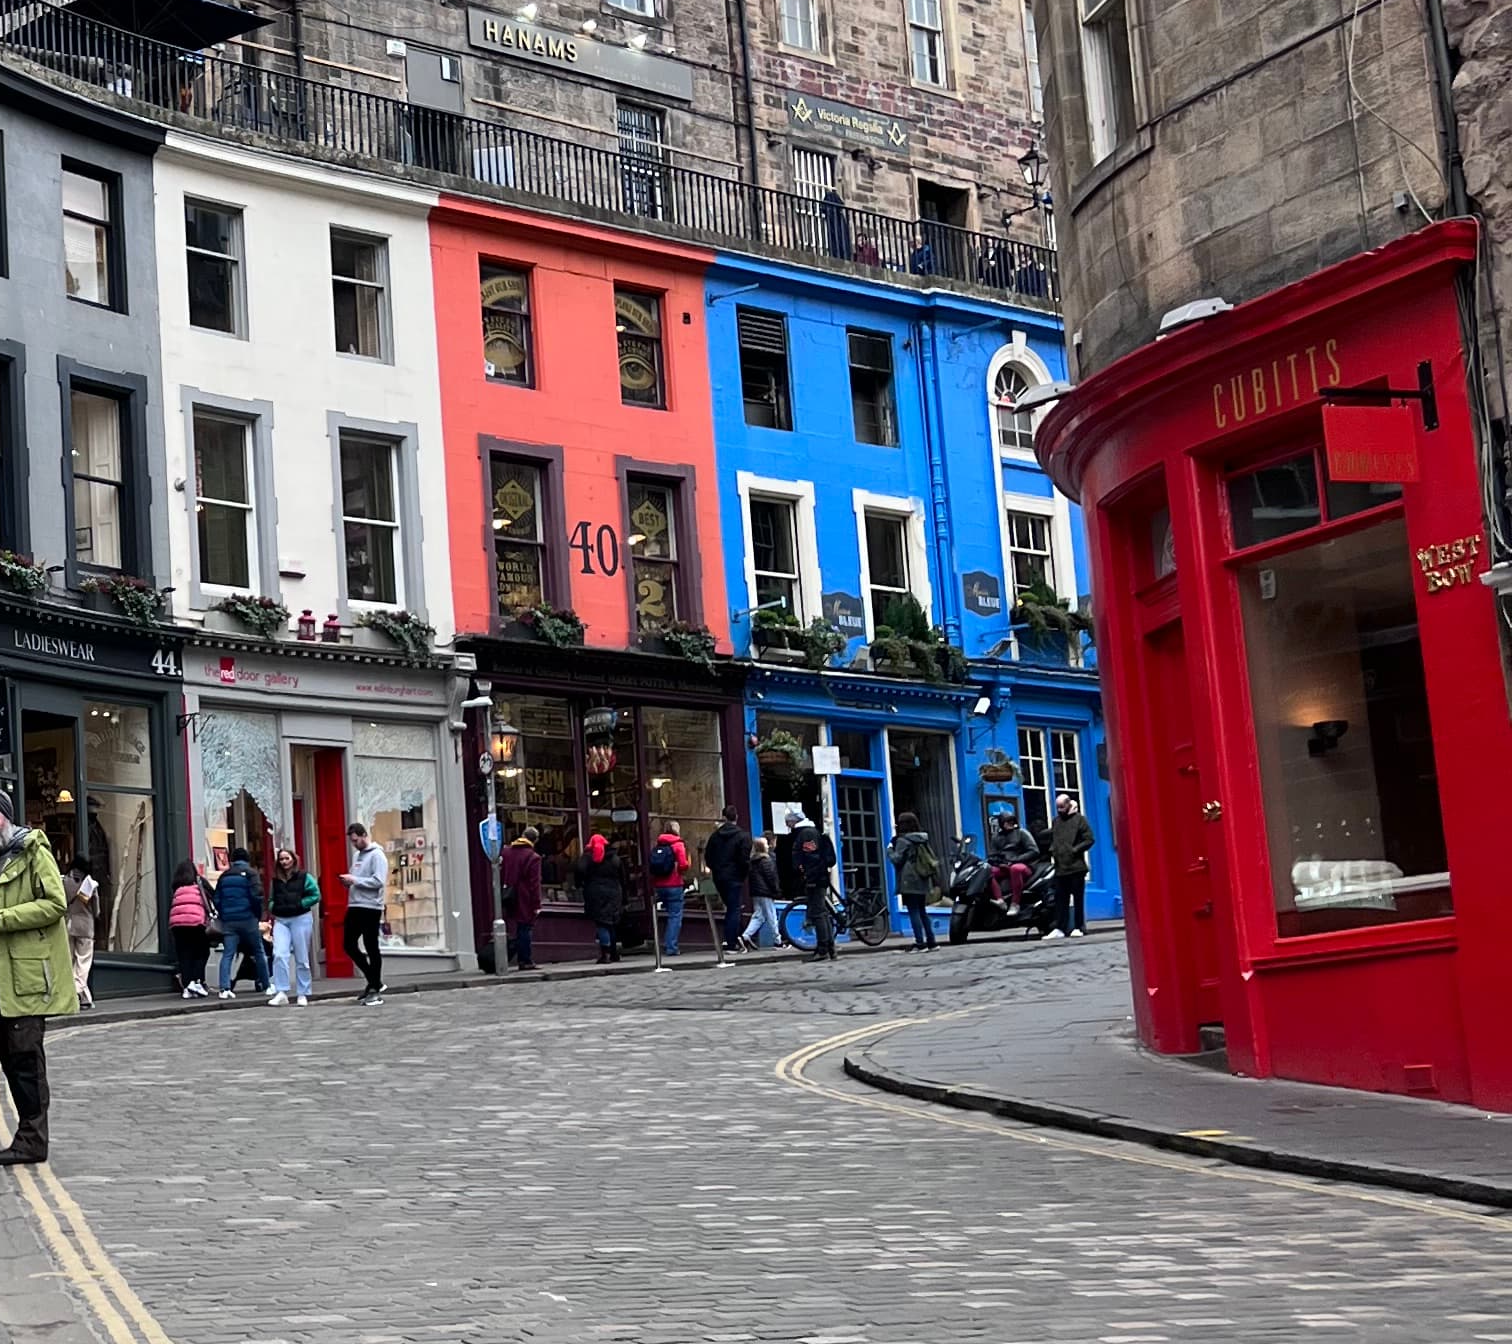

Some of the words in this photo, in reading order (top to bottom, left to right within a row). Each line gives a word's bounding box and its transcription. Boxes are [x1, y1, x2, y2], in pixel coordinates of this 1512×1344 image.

[483, 18, 579, 63] HANAMS
[816, 106, 851, 127] Victoria
[851, 116, 884, 136] Regalia
[1212, 338, 1342, 429] CUBITTS
[638, 510, 661, 526] BEST
[569, 520, 619, 577] 40
[1416, 534, 1481, 572] WEST
[496, 570, 536, 585] AMOUS
[1425, 559, 1475, 593] BOW
[14, 629, 95, 661] LADIESWEAR
[204, 665, 220, 678] the
[220, 667, 235, 680] red
[237, 669, 260, 683] door
[264, 672, 299, 689] gallery
